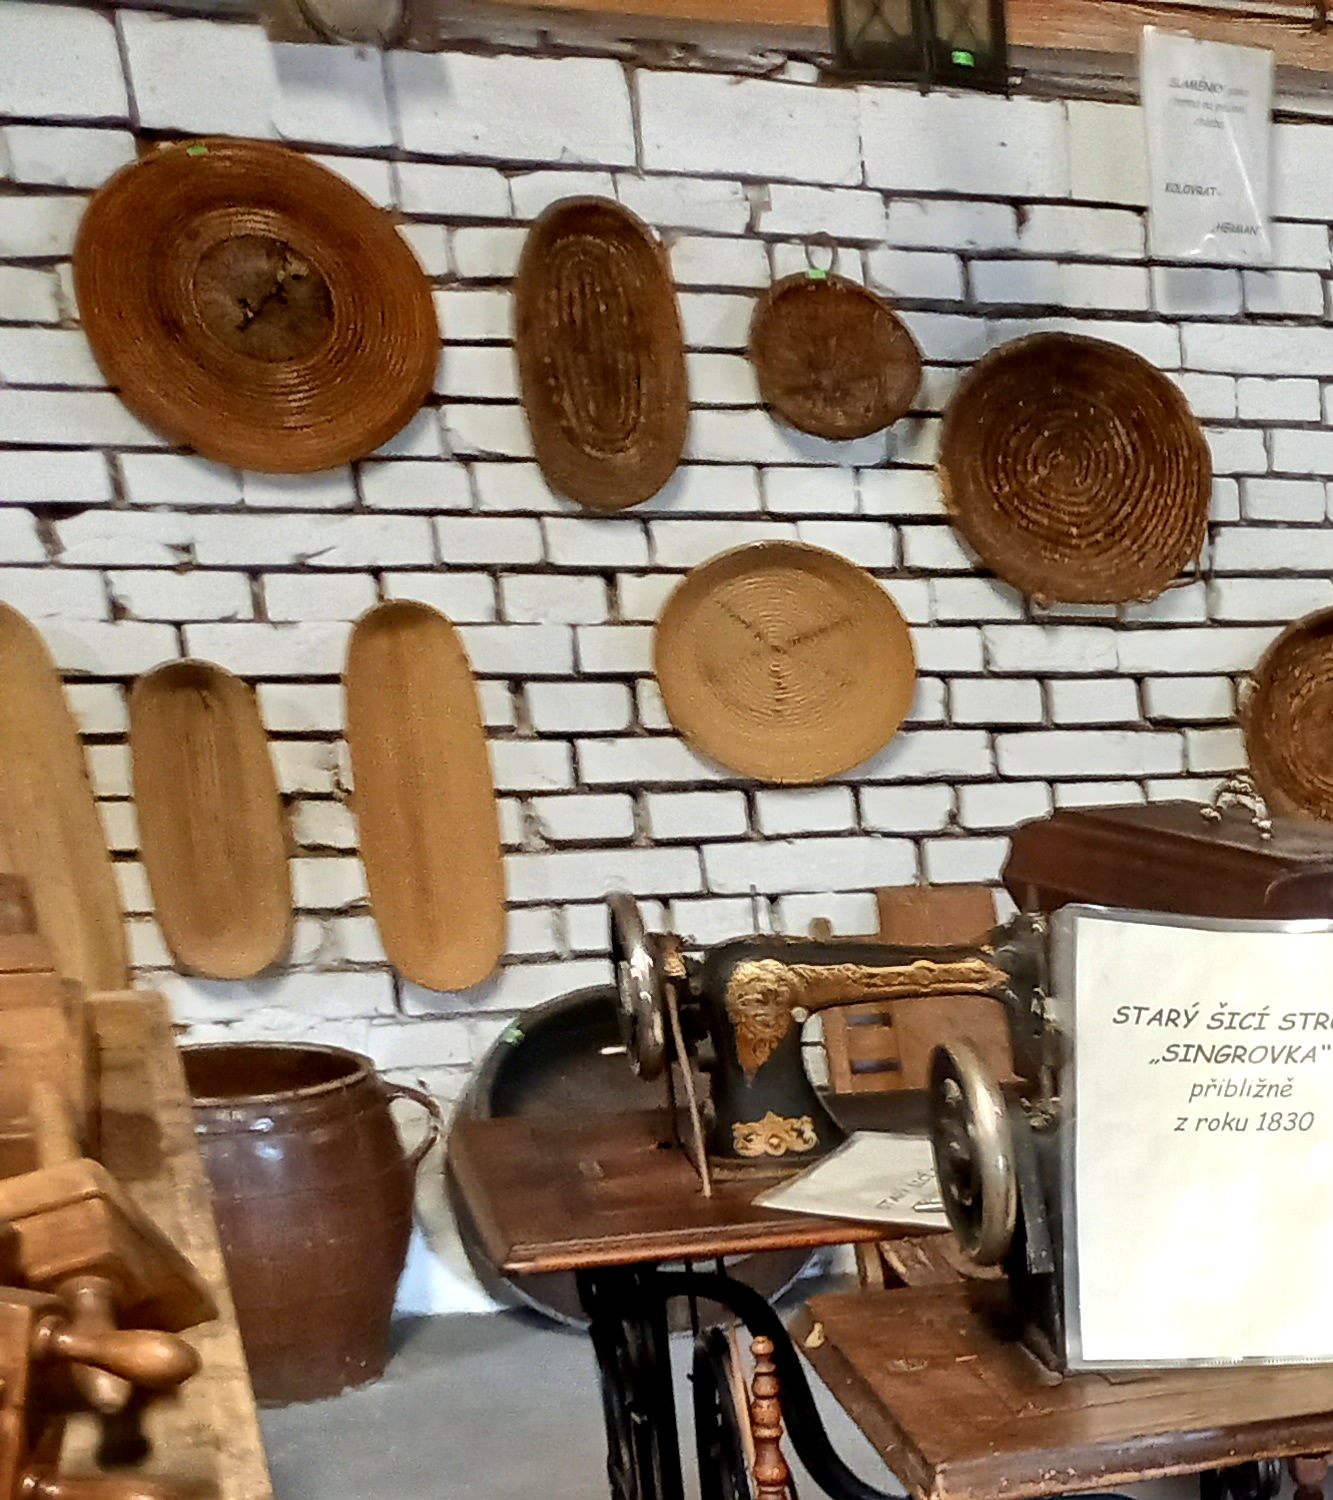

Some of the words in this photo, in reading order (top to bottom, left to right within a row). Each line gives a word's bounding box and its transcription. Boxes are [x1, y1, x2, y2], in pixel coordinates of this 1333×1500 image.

[1111, 1002, 1200, 1029] STARÝ
[1206, 1002, 1270, 1031] ŠICÍ
[1188, 1077, 1295, 1104] přibližně
[1173, 1116, 1189, 1132] z
[1194, 1111, 1249, 1132] roku
[1255, 1111, 1316, 1132] 1830
